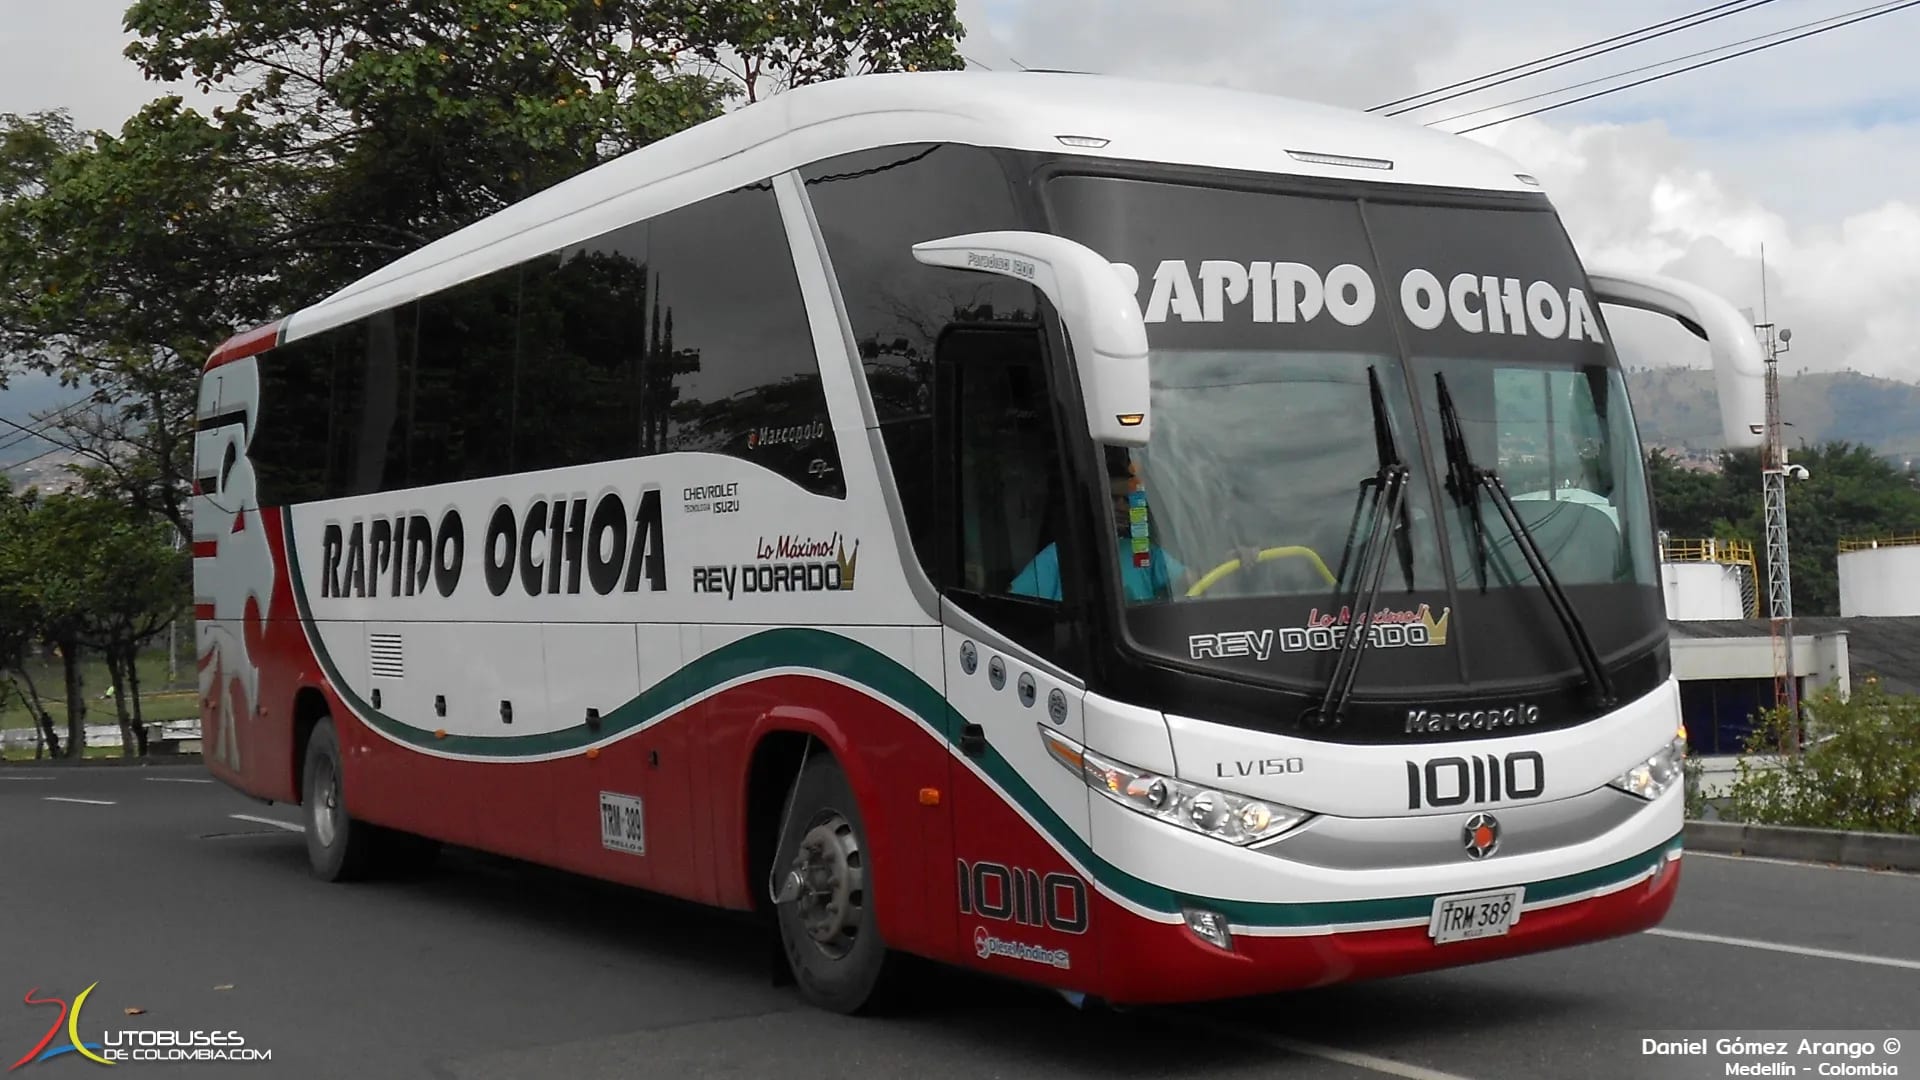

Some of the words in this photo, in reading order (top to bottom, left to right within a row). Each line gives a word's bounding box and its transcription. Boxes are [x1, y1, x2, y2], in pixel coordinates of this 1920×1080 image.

[1400, 268, 1604, 343] OCHOA
[758, 421, 824, 446] Marcopolo
[683, 482, 739, 501] CHEVROLET
[712, 500, 740, 514] ISUZU
[321, 504, 465, 598] RAPIDO
[483, 482, 668, 597] OCHOA
[757, 536, 774, 560] Lo
[776, 531, 837, 559] Máximo!
[742, 561, 841, 592] DORADO
[1307, 607, 1337, 627] Lo
[1404, 703, 1540, 734] Marcopolo
[1406, 750, 1545, 810] 10110
[601, 803, 622, 838] TRM
[625, 806, 642, 841] 389
[957, 857, 1089, 935] 10110
[1443, 906, 1476, 932] TRM
[1478, 901, 1512, 927] 389
